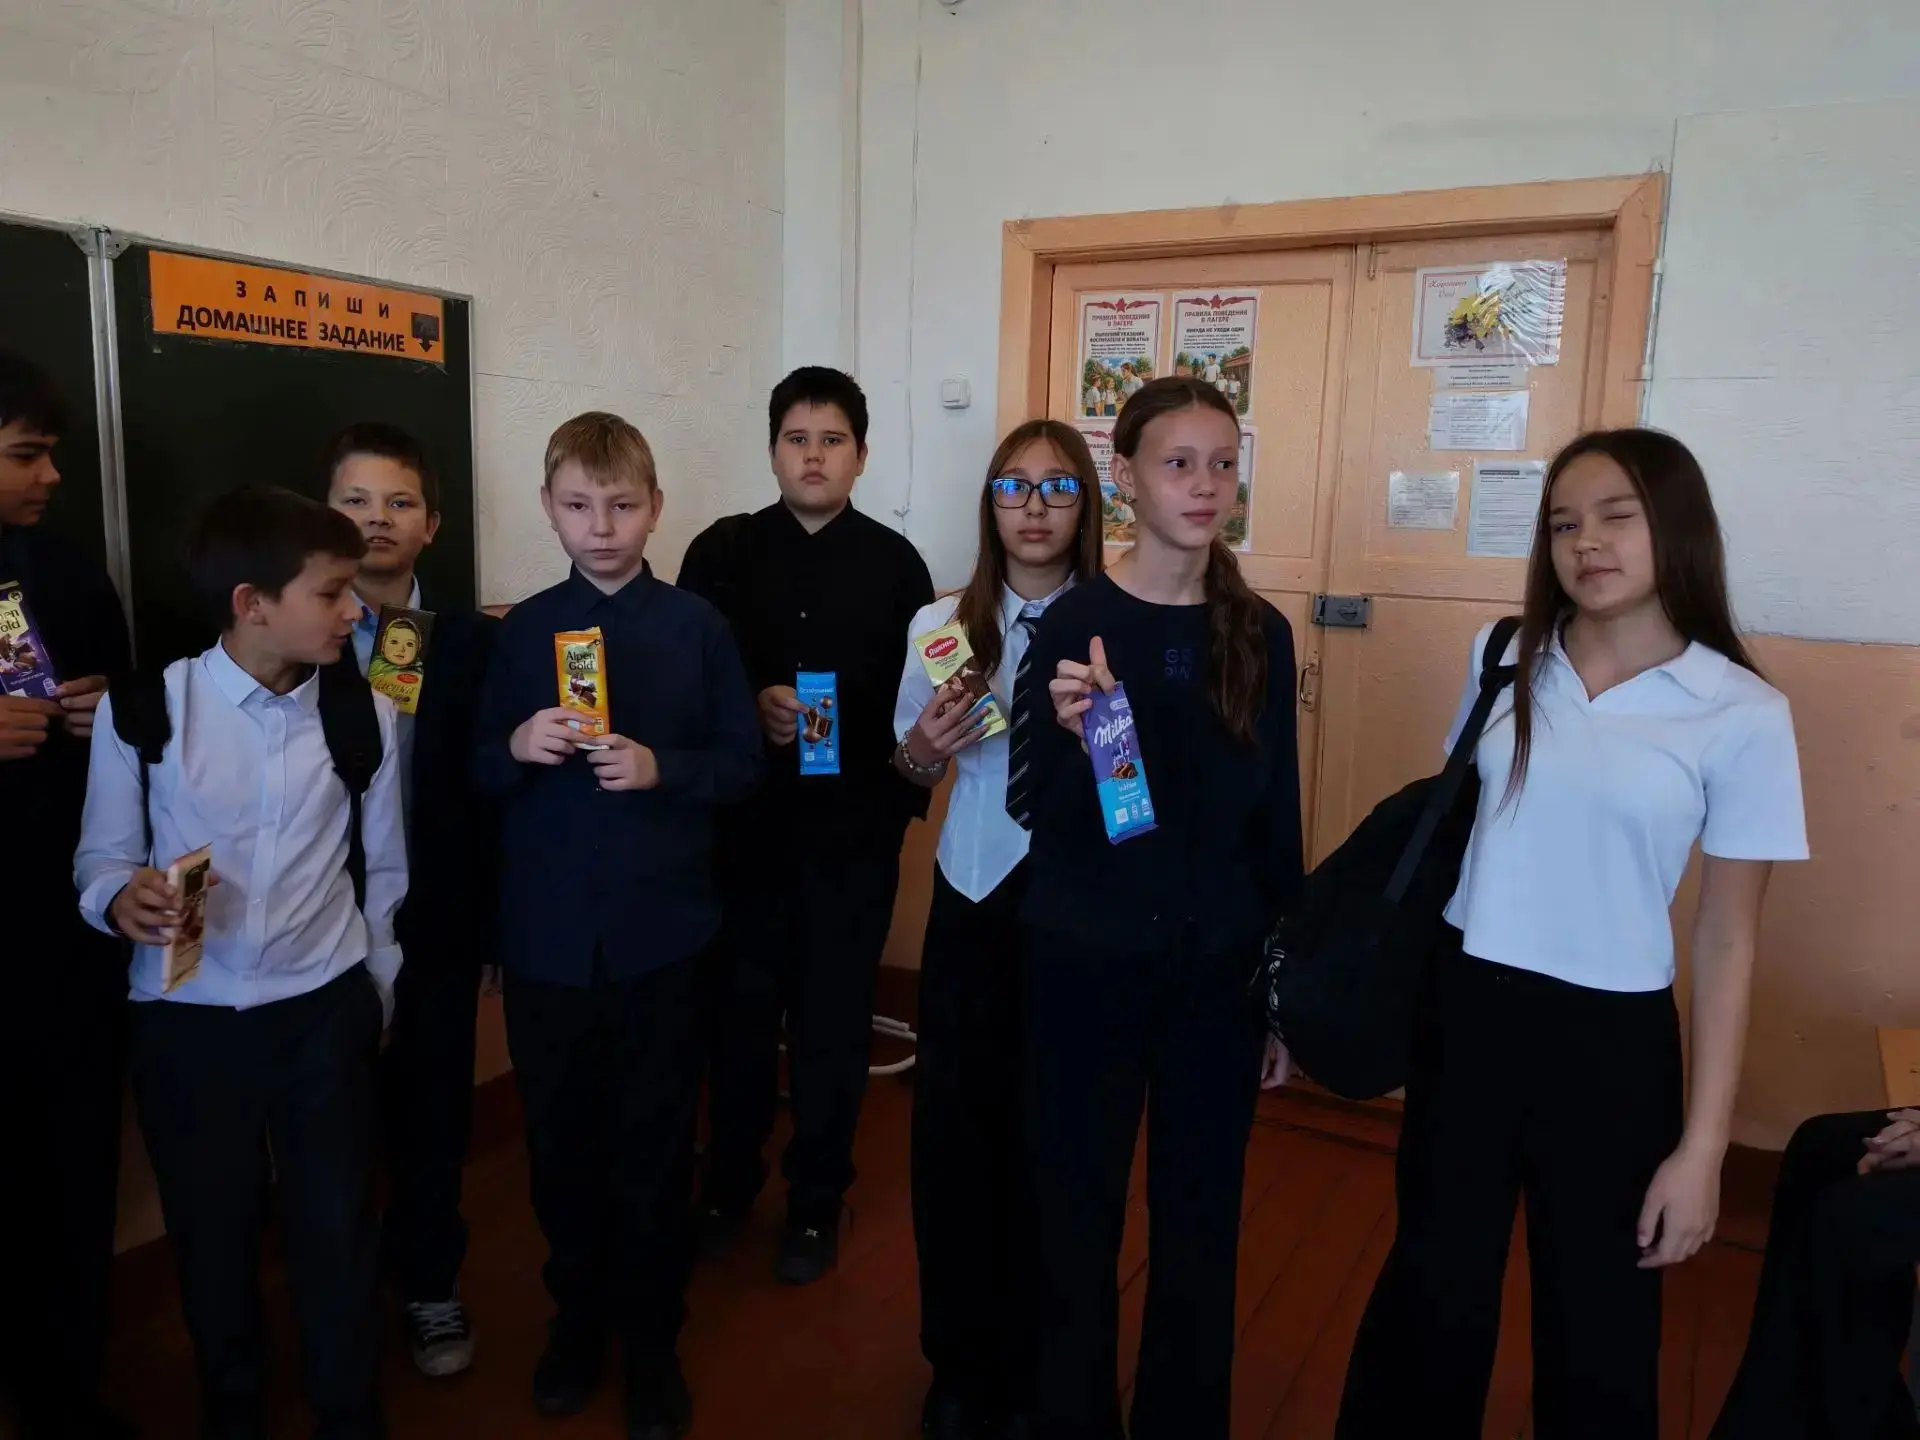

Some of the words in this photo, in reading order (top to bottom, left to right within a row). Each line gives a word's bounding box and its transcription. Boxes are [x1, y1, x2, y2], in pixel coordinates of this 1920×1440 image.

[1184, 310, 1212, 318] ПРАВИЛА
[1212, 309, 1248, 317] ПОВЕДЕНИЯ
[176, 304, 308, 341] ДОМАШНЕЕ
[318, 321, 406, 353] ЗАДАНИЕ
[0, 618, 21, 633] old
[565, 650, 595, 663] Alpen
[568, 660, 594, 671] Gold
[1094, 714, 1134, 748] Milka
